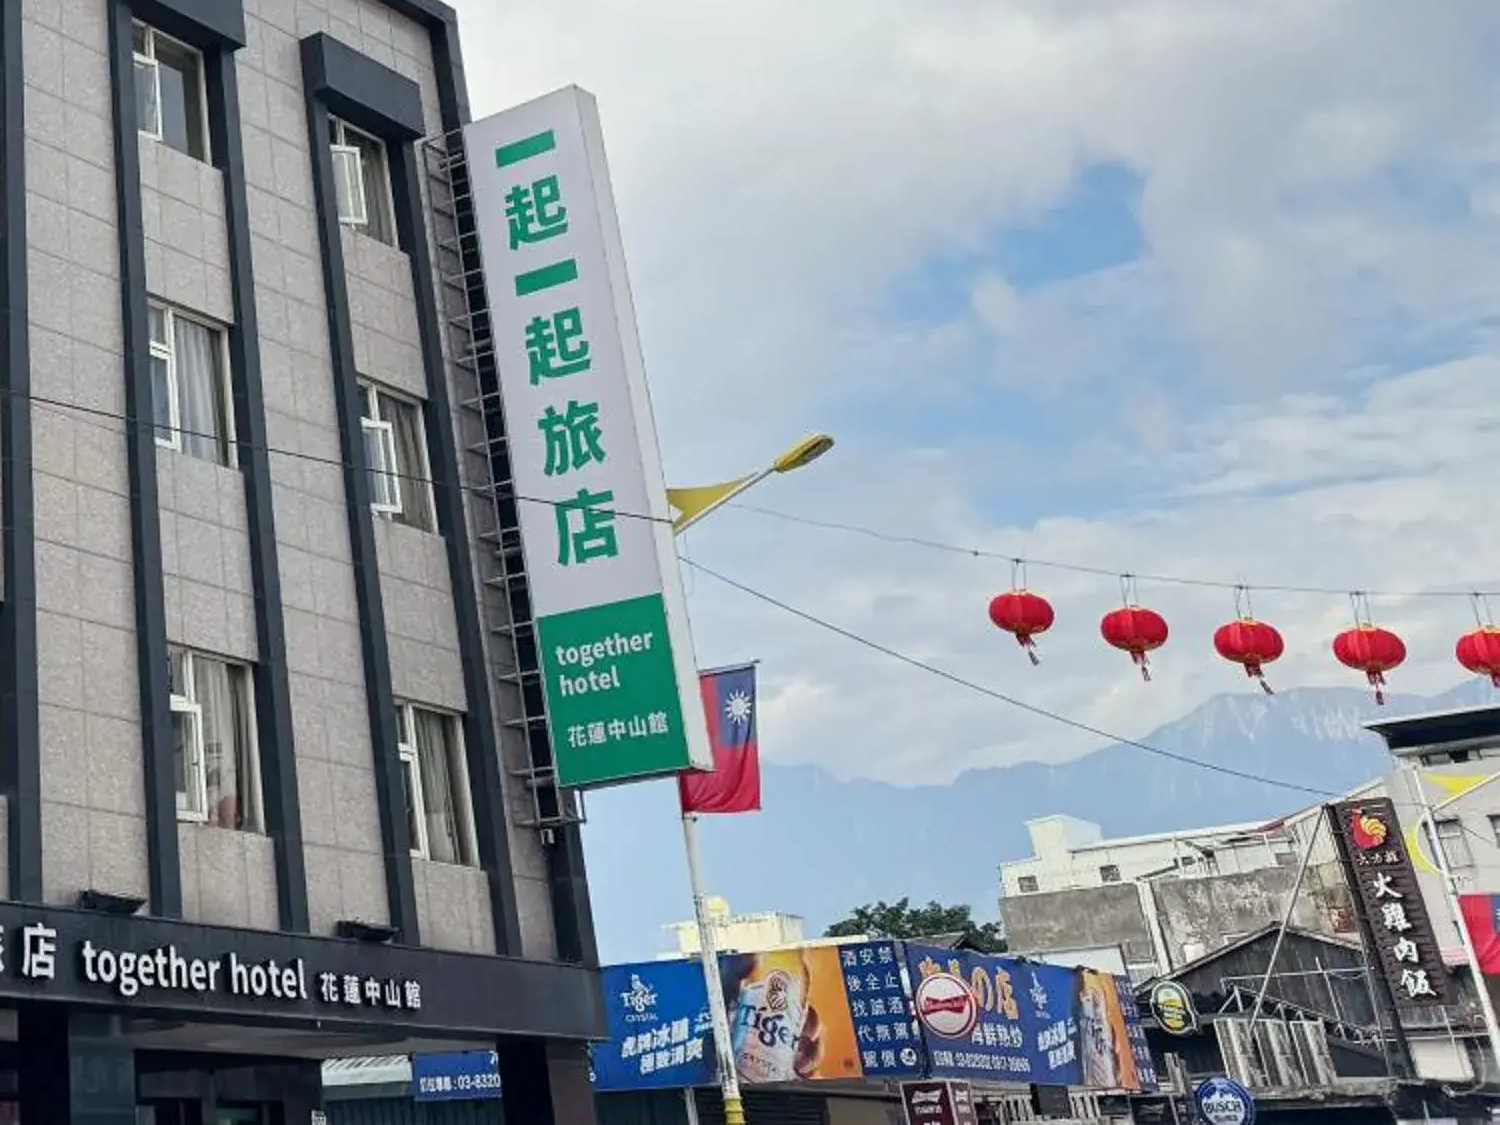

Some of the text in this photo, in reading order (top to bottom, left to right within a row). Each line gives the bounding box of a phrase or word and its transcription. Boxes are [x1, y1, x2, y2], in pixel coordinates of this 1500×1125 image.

[495, 129, 619, 566] 一起一起旅店
[555, 632, 653, 667] together
[560, 665, 621, 698] hotel
[567, 711, 669, 748] 花蓮中山館
[82, 940, 221, 996] together
[230, 952, 307, 999] hotel
[320, 971, 421, 1009] 花蓮中山館
[620, 990, 659, 1012] Tiger
[740, 1005, 802, 1058] Tiger
